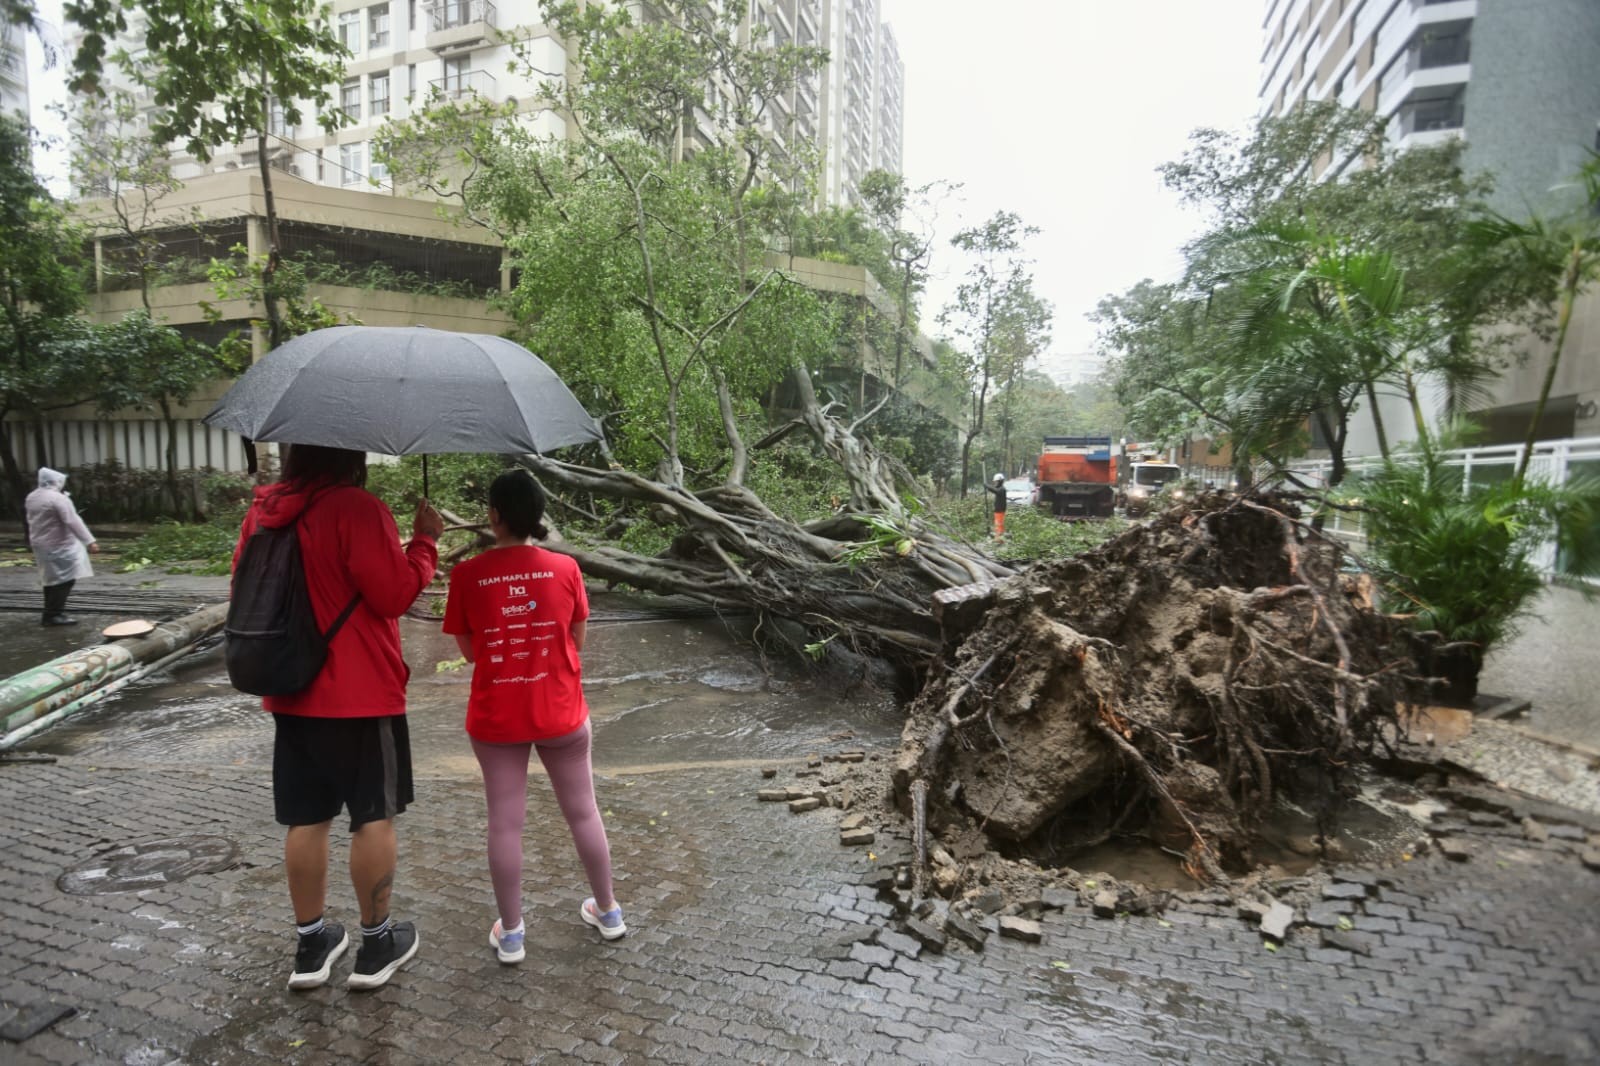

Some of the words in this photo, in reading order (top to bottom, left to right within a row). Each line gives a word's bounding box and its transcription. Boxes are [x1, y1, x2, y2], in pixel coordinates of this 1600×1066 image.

[478, 577, 501, 587] TEAM
[502, 572, 530, 582] MAPLE
[532, 571, 554, 580] BEAR
